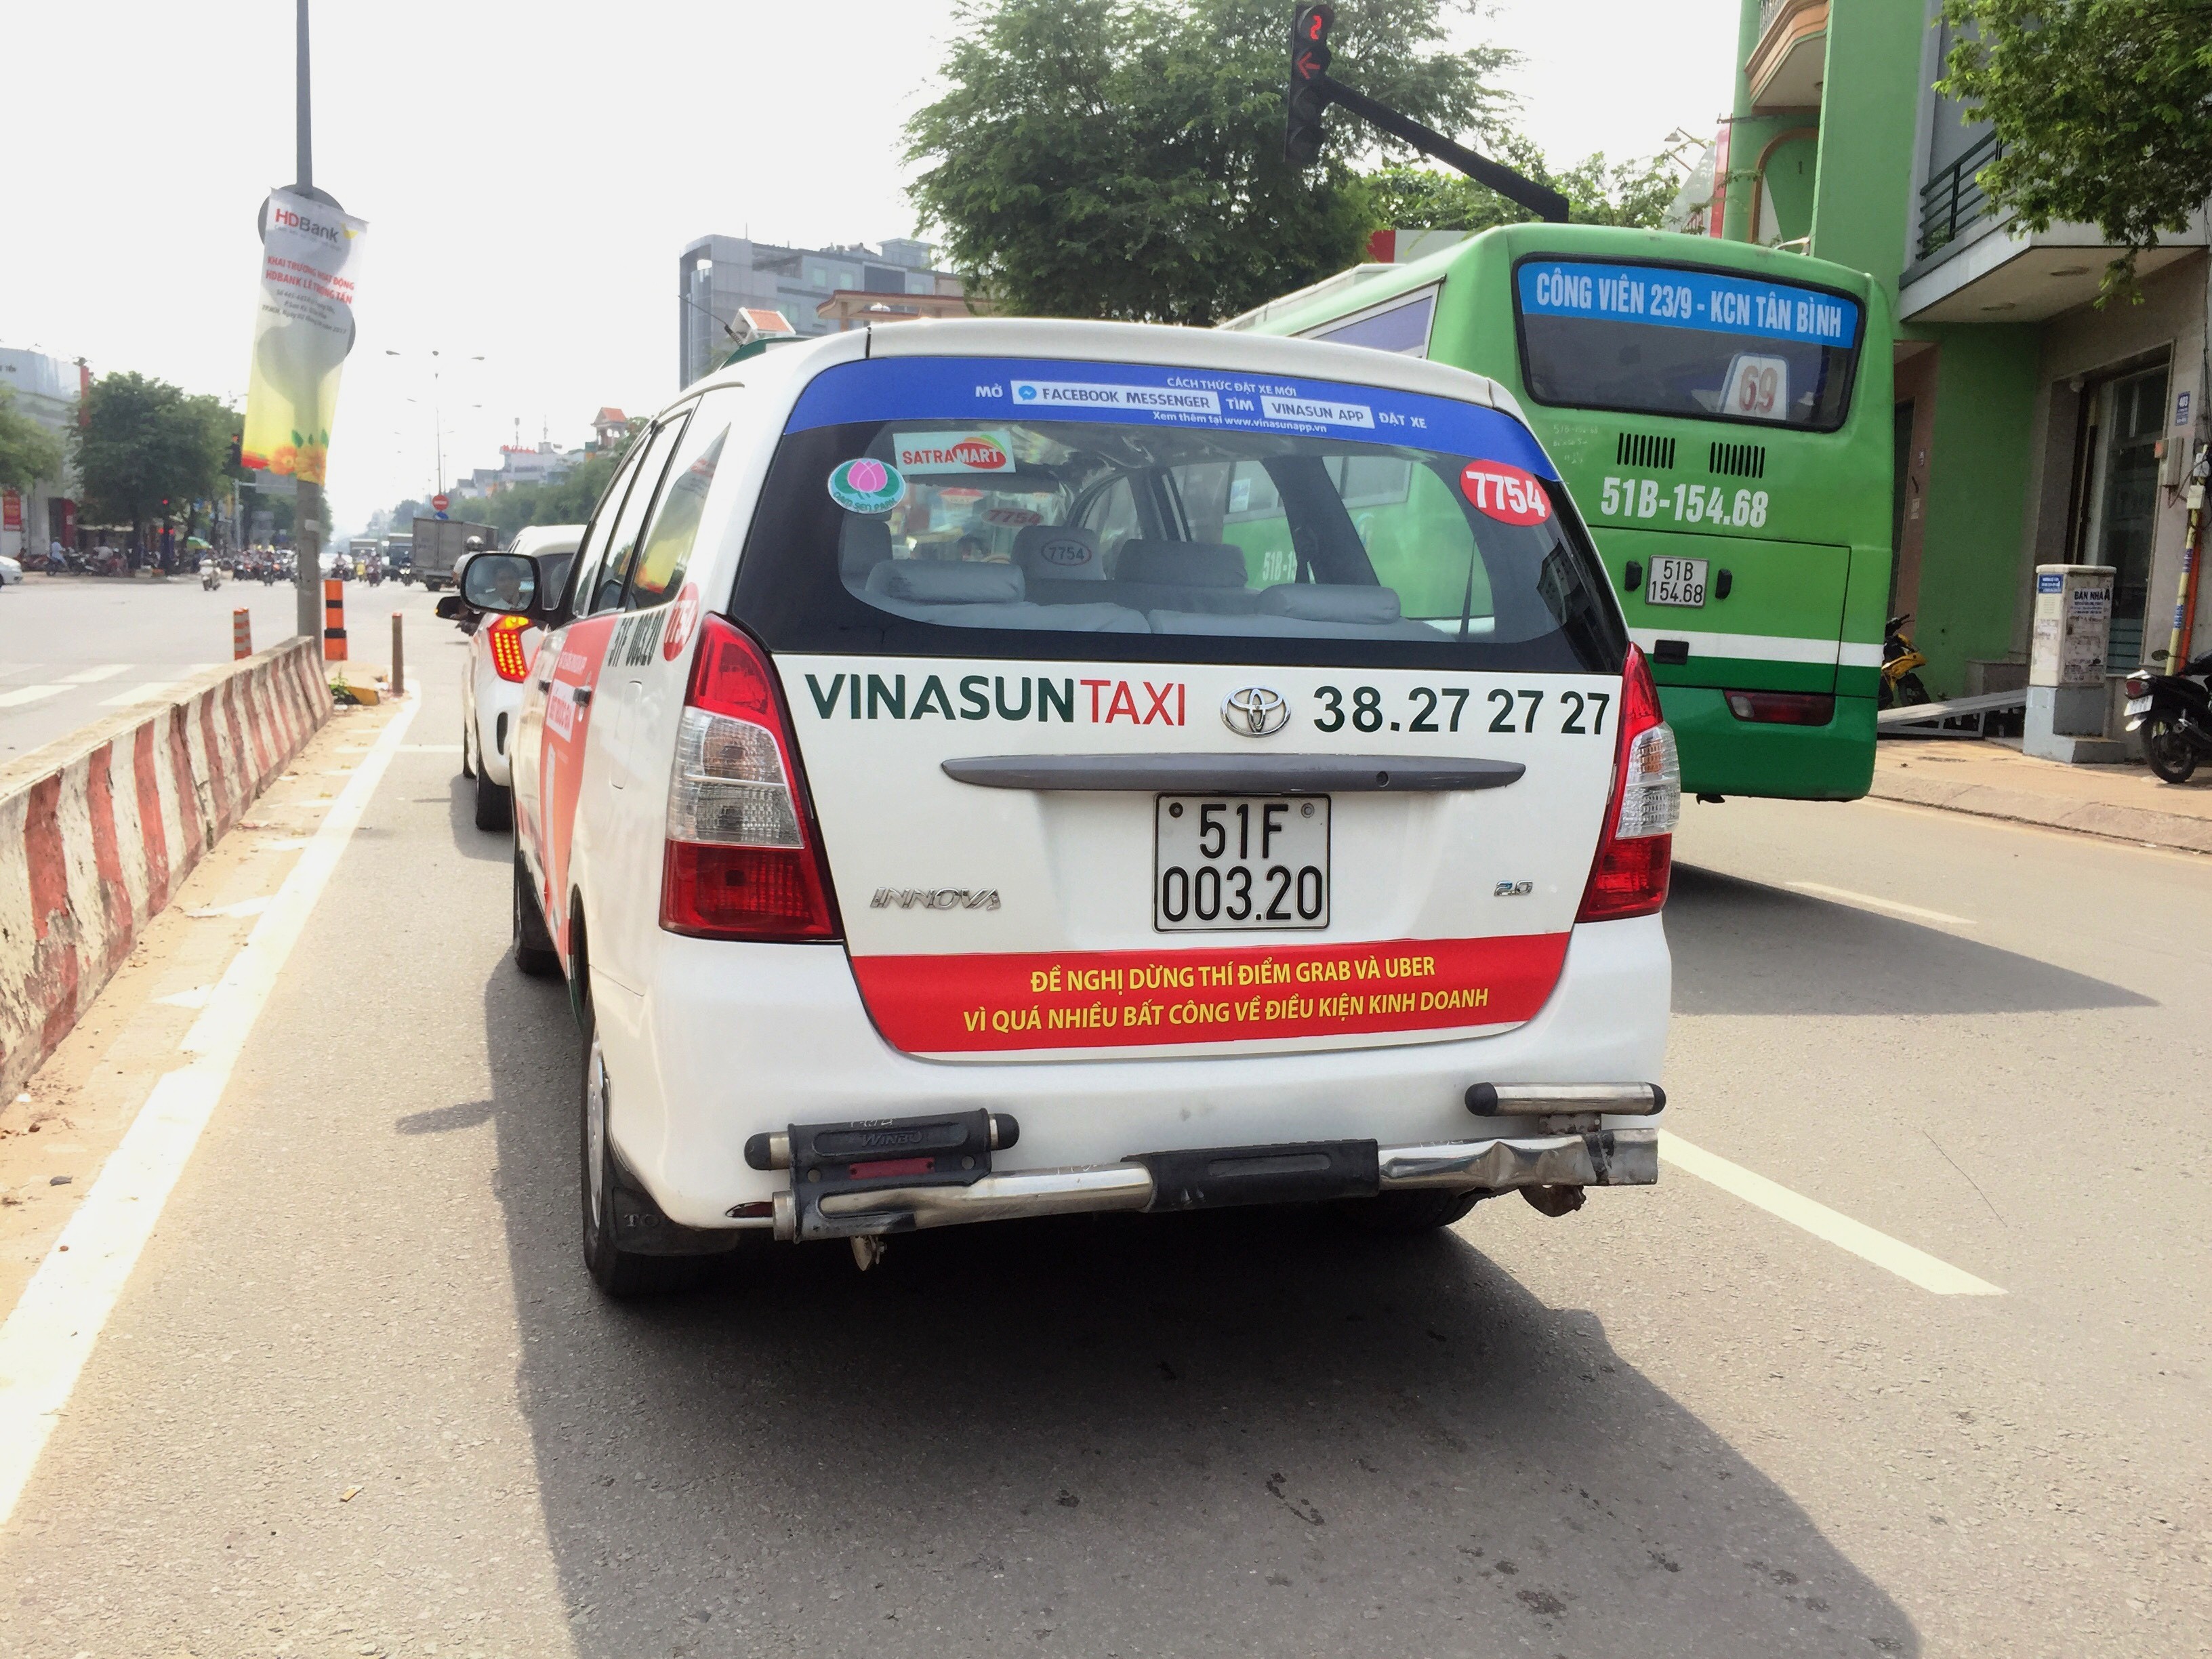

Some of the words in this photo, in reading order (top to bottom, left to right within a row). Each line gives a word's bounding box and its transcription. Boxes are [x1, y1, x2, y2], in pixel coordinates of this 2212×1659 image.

[274, 208, 339, 243] HDBank
[266, 270, 302, 287] HDBANK
[1536, 267, 1592, 309] CÔNG
[1598, 273, 1644, 314] VIÊN
[1650, 283, 1692, 319] 23/9
[1711, 290, 1750, 326] KCN
[1756, 291, 1791, 331] TÂN
[1797, 296, 1841, 337] BÌNH
[975, 384, 1003, 398] MỞ
[1042, 388, 1120, 403] FACEBOOK
[1126, 392, 1210, 408] MESSENGER
[1226, 396, 1254, 411] TÌM
[1271, 402, 1333, 419] VINASUN
[1338, 409, 1364, 422] APP
[1378, 412, 1406, 427] ĐẶT
[1410, 417, 1427, 429] XE
[1167, 377, 1200, 389] CÁCH
[1200, 379, 1233, 392] THỨC
[1234, 382, 1256, 394] ĐẶT
[1258, 384, 1273, 394] XE
[1275, 384, 1297, 396] MỚI
[1739, 365, 1778, 413] 69
[1153, 411, 1177, 421] Xem
[1179, 413, 1207, 424] thêm
[1208, 414, 1222, 426] tại
[1224, 416, 1327, 433] www.vinasunapp.vn
[902, 448, 998, 466] SATRAMART
[1465, 470, 1546, 517] 7754
[1600, 476, 1769, 528] 51B-154.68
[1048, 547, 1084, 560] 7754
[1663, 560, 1694, 581] 51B
[1652, 581, 1703, 604] 154.68
[1313, 684, 1471, 733] 38.27
[1487, 689, 1544, 733] 27
[1560, 691, 1610, 735] 27
[1200, 804, 1288, 859] 51F
[869, 886, 1002, 911] INNOVA
[1162, 865, 1323, 922] 003.20
[1030, 964, 1062, 993] ĐỀ
[1067, 968, 1123, 996] NGHỊ
[1129, 964, 1194, 990] DỪNG
[1197, 961, 1233, 987] THÍ
[1237, 956, 1291, 985] ĐIỂM
[1295, 960, 1351, 983] GRAB
[1354, 955, 1380, 980] VÀ
[1385, 956, 1435, 979] UBER
[963, 1006, 986, 1032] VÌ
[991, 1005, 1042, 1033] QUÁ
[1048, 1001, 1118, 1029] NHIỀU
[1122, 999, 1164, 1027] BẤT
[1168, 1000, 1230, 1025] CÔNG
[1234, 995, 1262, 1022] VỀ
[1265, 993, 1313, 1021] ĐIỀU
[1318, 993, 1364, 1022] KIỆN
[1368, 992, 1416, 1015] KINH
[1420, 988, 1489, 1012] DOANH
